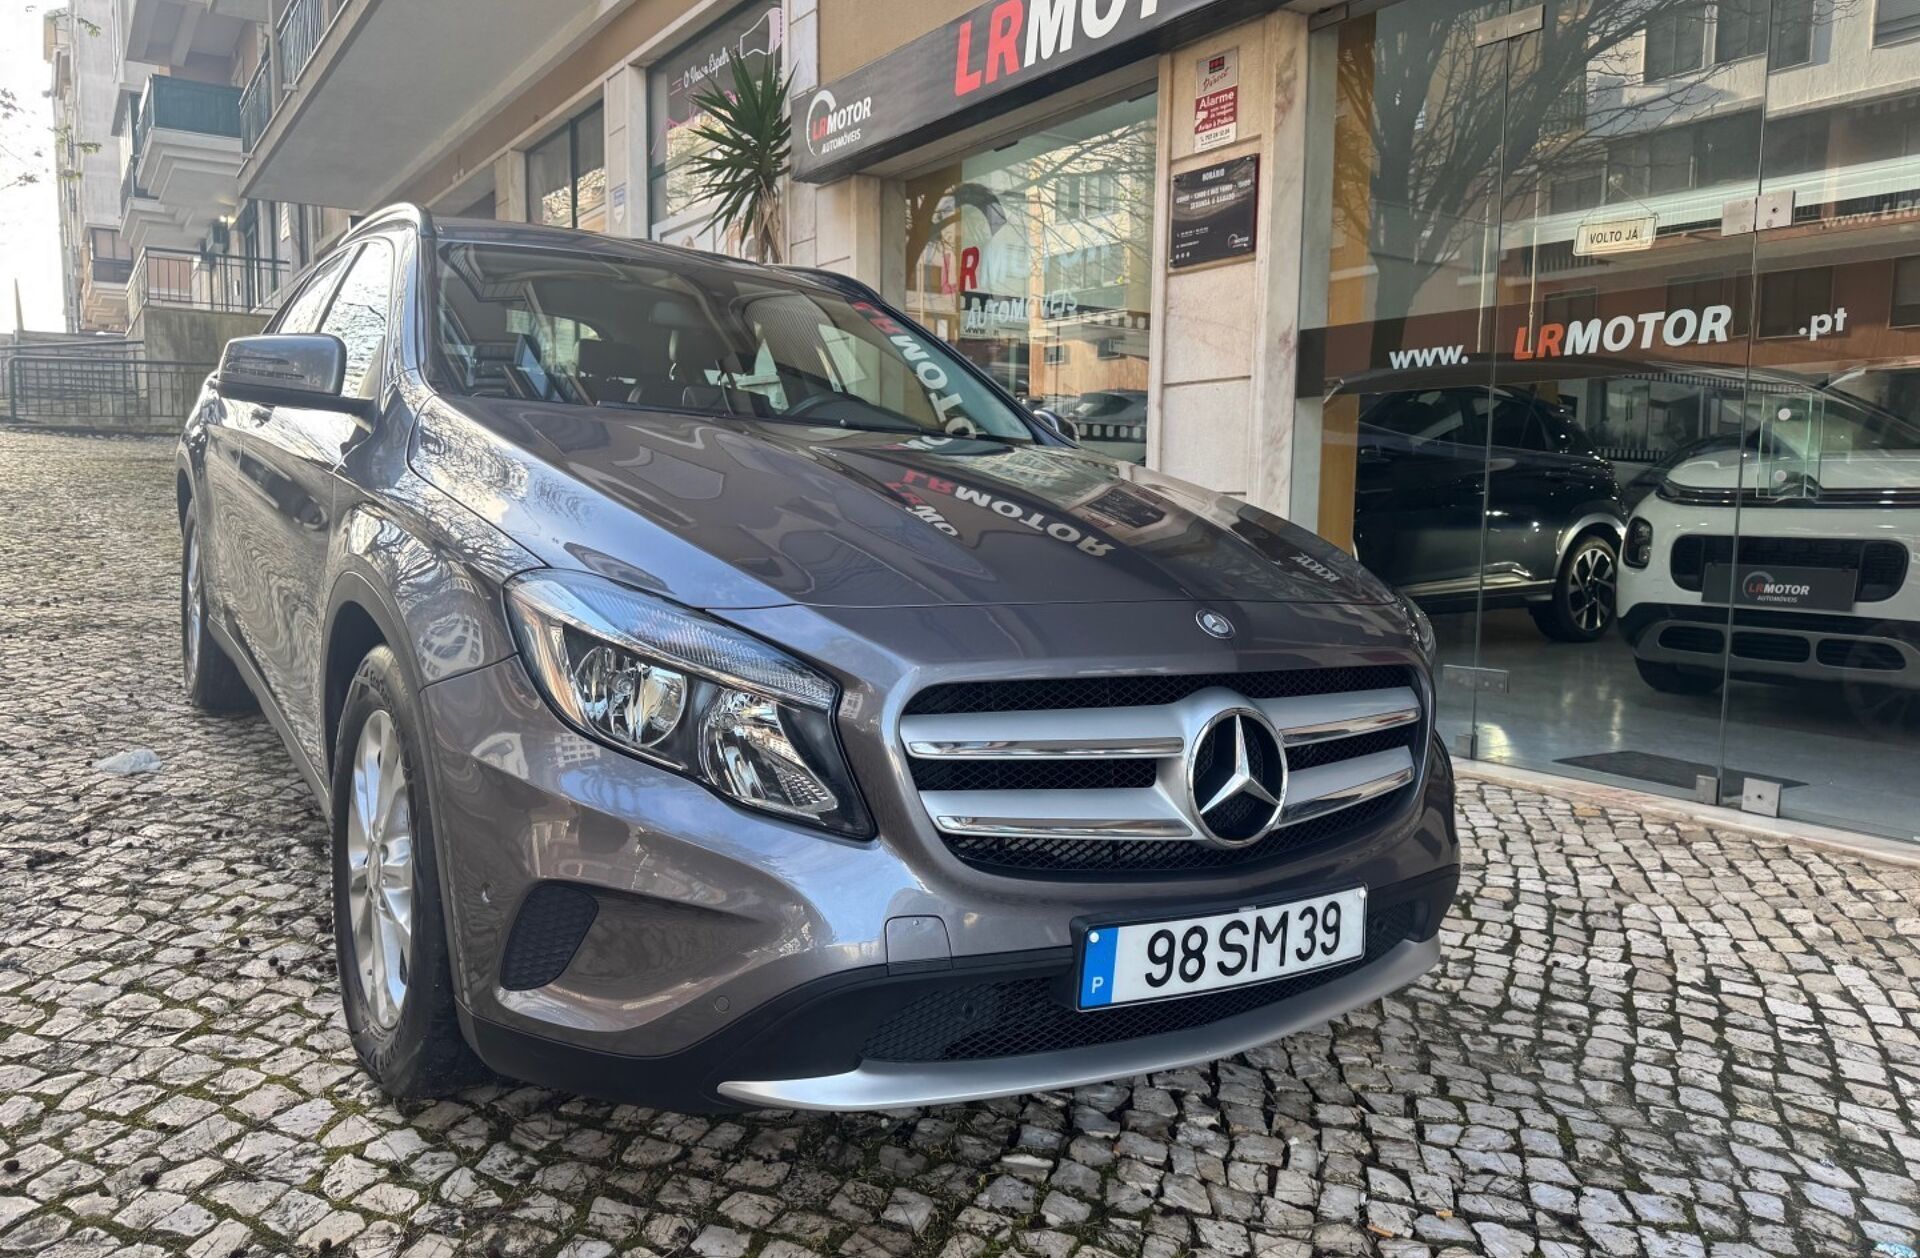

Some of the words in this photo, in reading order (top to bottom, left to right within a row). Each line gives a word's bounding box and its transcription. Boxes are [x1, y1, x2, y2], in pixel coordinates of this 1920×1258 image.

[1199, 91, 1234, 110] Alarme
[812, 96, 872, 141] LRMOTOR
[1590, 230, 1622, 244] VOLTO
[1625, 226, 1638, 240] JÁ
[1389, 345, 1468, 370] www.
[1514, 304, 1731, 360] LRMOTOR
[1799, 307, 1847, 341] .pt
[1748, 583, 1810, 596] LRMOTOR
[1091, 976, 1104, 994] P
